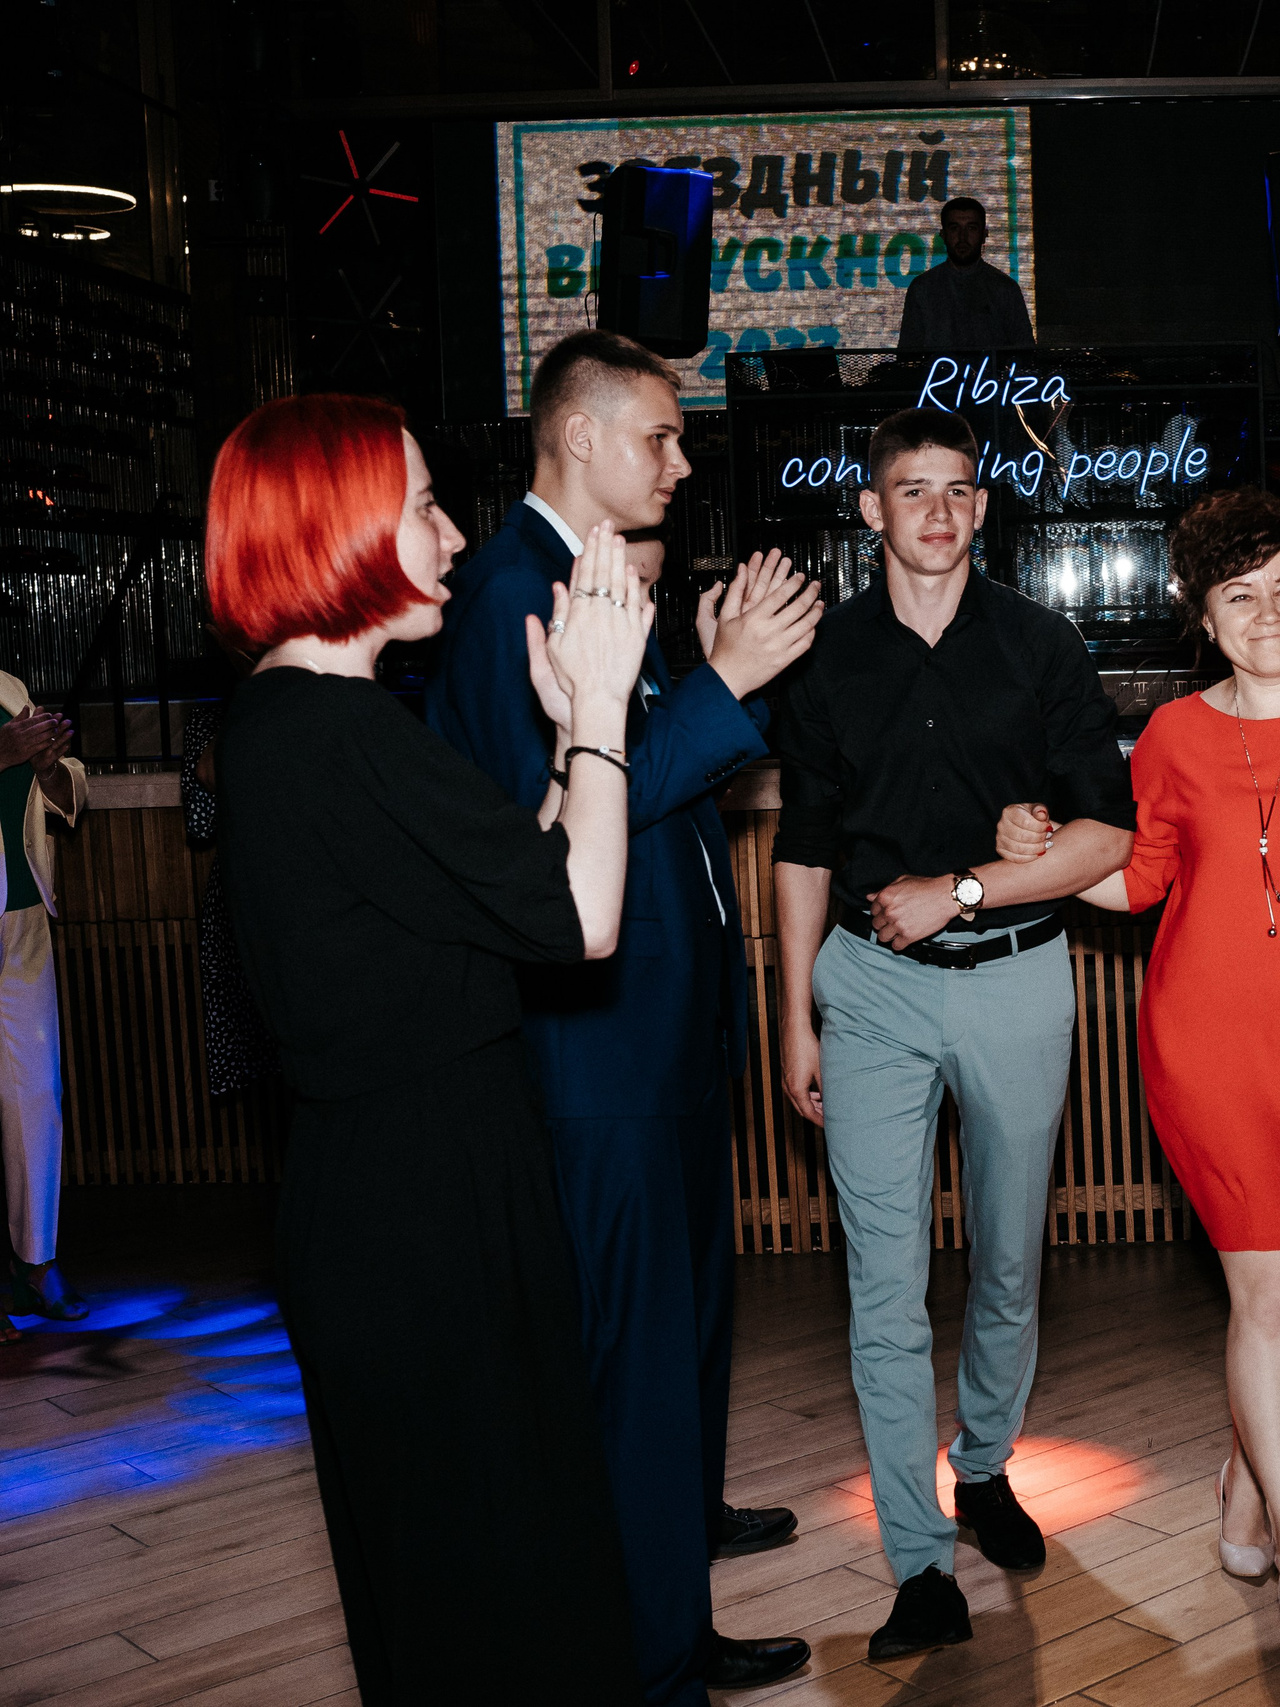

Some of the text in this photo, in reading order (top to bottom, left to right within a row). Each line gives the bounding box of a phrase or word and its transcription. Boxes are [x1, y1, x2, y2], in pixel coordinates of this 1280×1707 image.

[577, 131, 951, 219] ЗЗДНЫЙ
[546, 235, 948, 298] ВУСКНО
[916, 356, 1071, 413] Ribiza
[780, 425, 1208, 498] coning people
